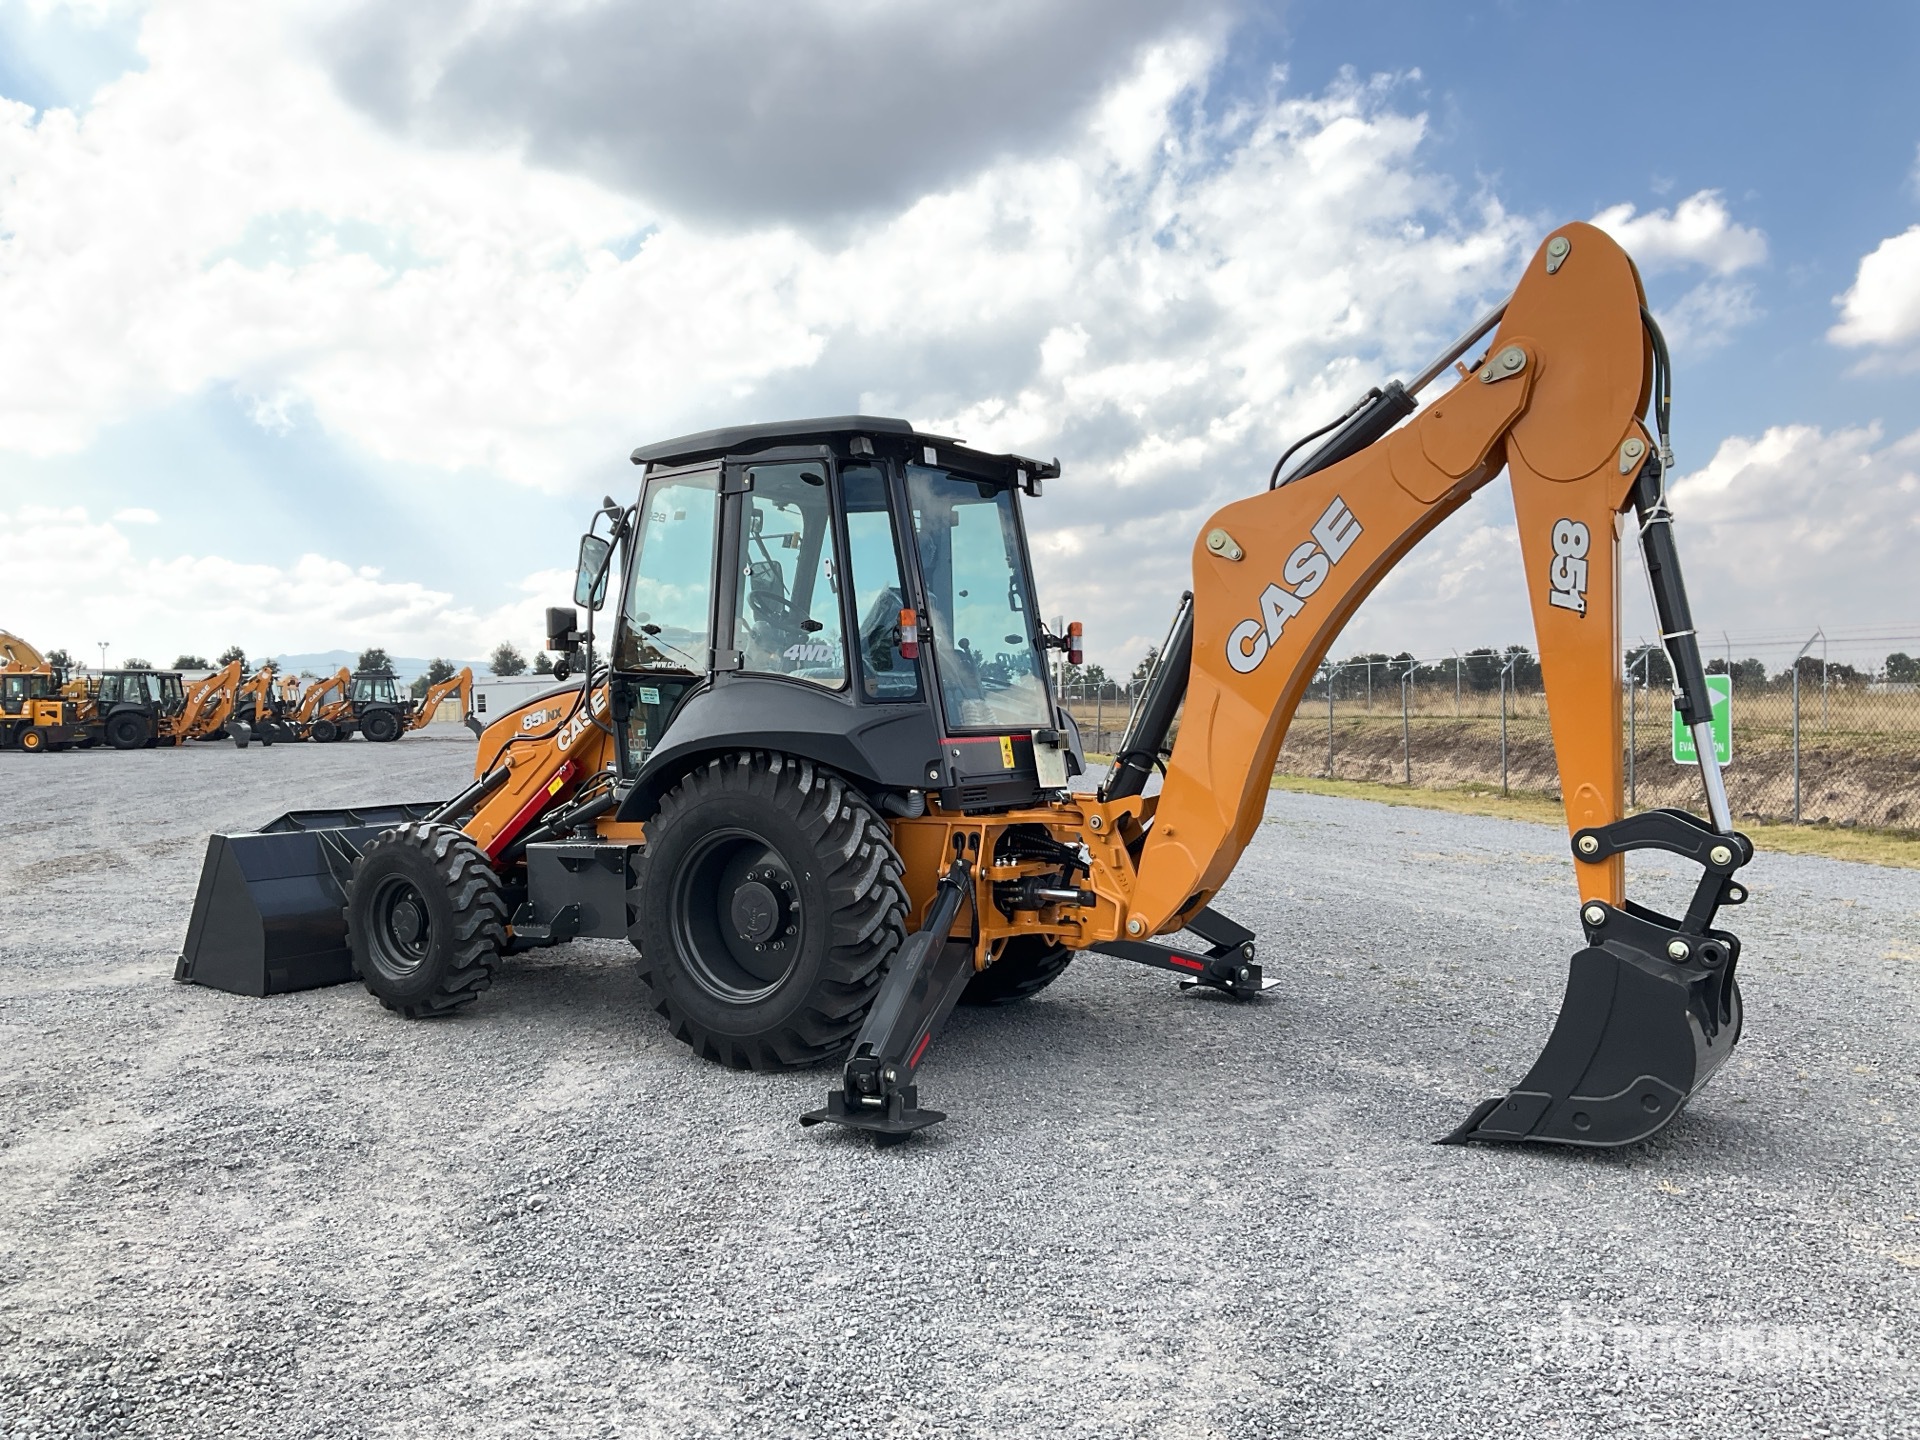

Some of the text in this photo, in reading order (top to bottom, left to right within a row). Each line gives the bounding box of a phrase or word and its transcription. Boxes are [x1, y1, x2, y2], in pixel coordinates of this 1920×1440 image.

[1226, 494, 1364, 674] CASE
[1550, 518, 1590, 614] 851
[783, 644, 834, 662] 4WD
[193, 684, 211, 704] CASE
[557, 690, 607, 751] CASE
